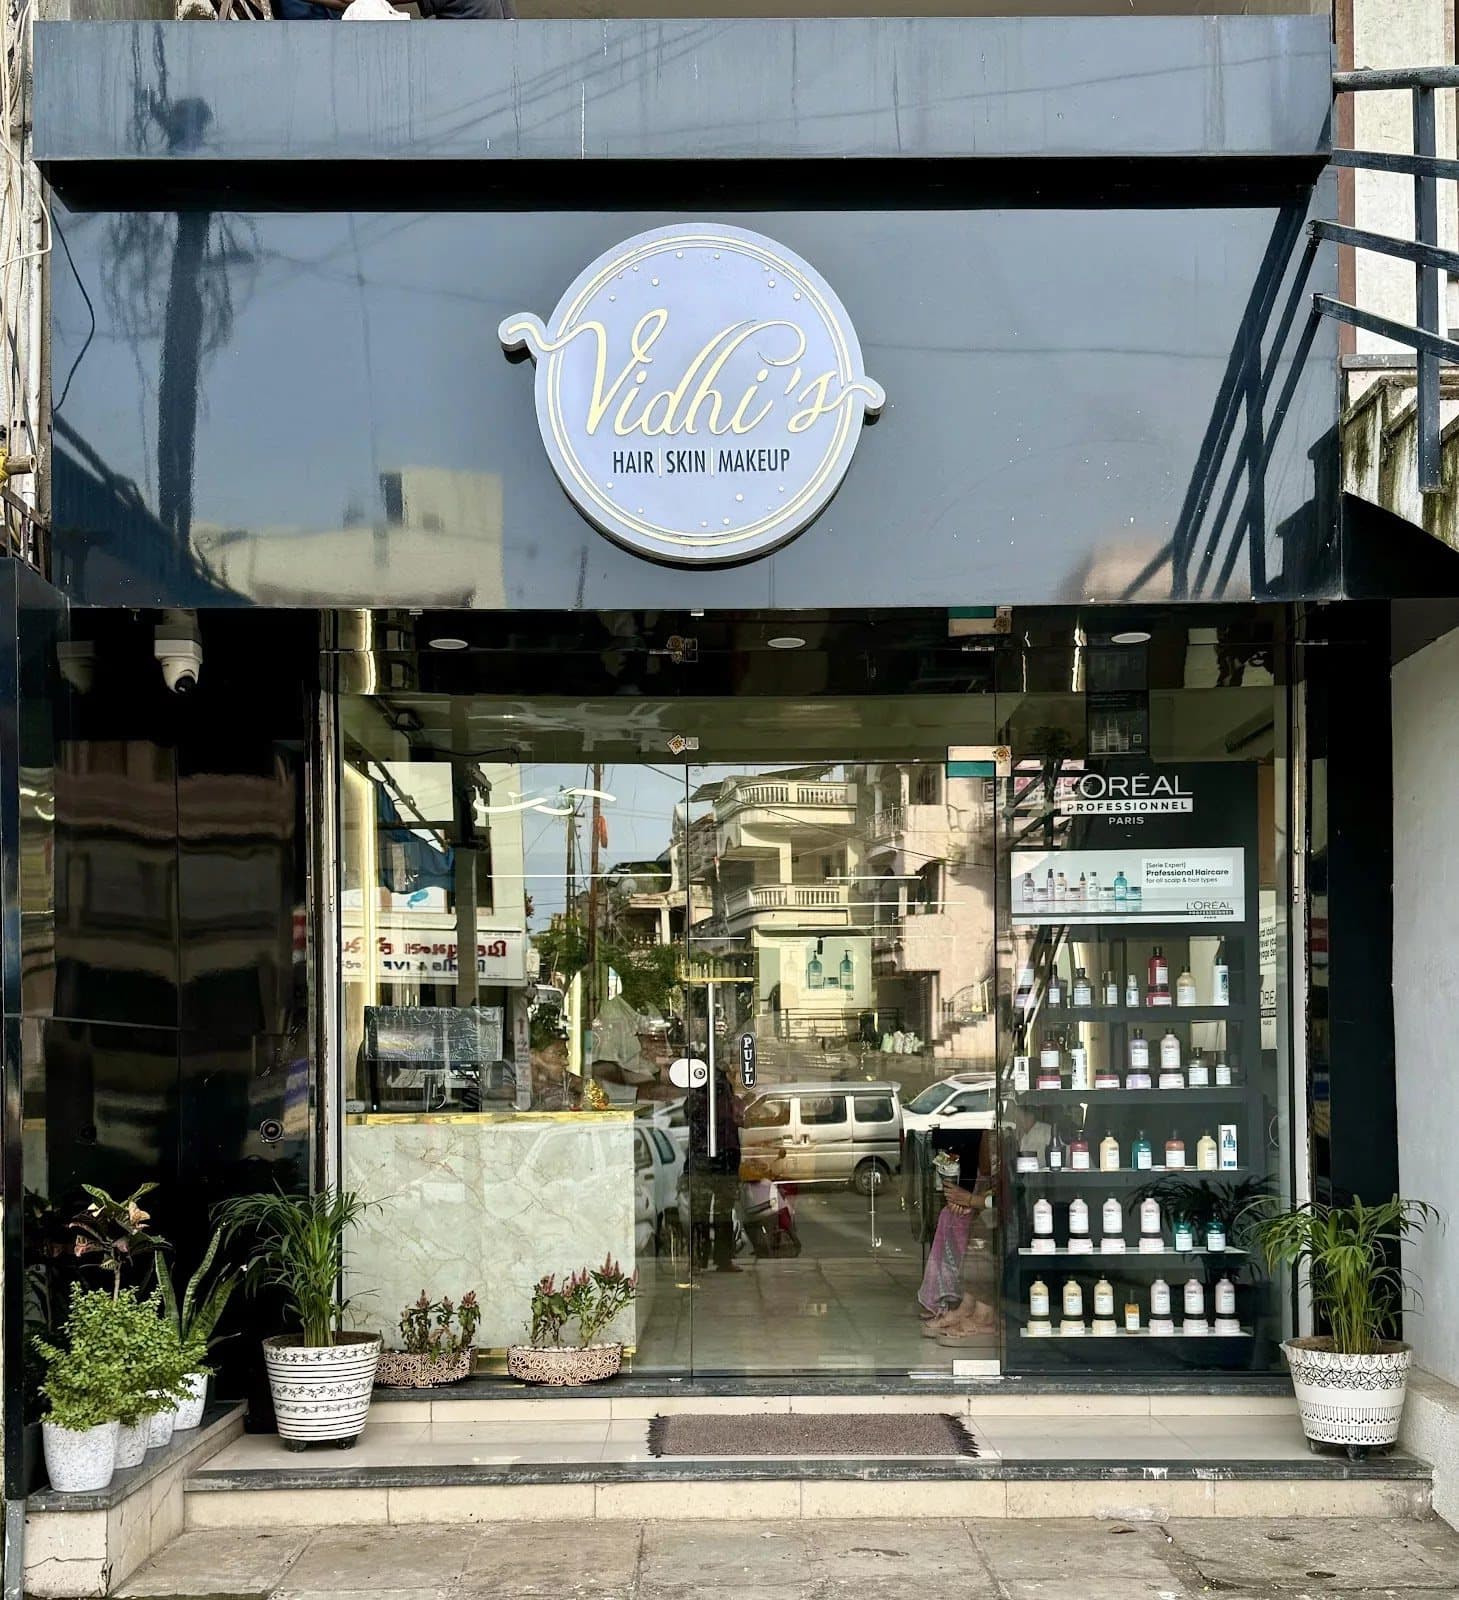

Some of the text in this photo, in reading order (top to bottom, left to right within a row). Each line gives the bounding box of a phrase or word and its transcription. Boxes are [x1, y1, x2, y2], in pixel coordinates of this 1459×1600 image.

[507, 308, 877, 436] Vidhi's
[612, 449, 790, 474] HAIR SKIN MAKEUP
[1067, 801, 1188, 812] PROFESSIONNEL
[1108, 816, 1145, 825] PARIS
[743, 1037, 754, 1085] PULL
